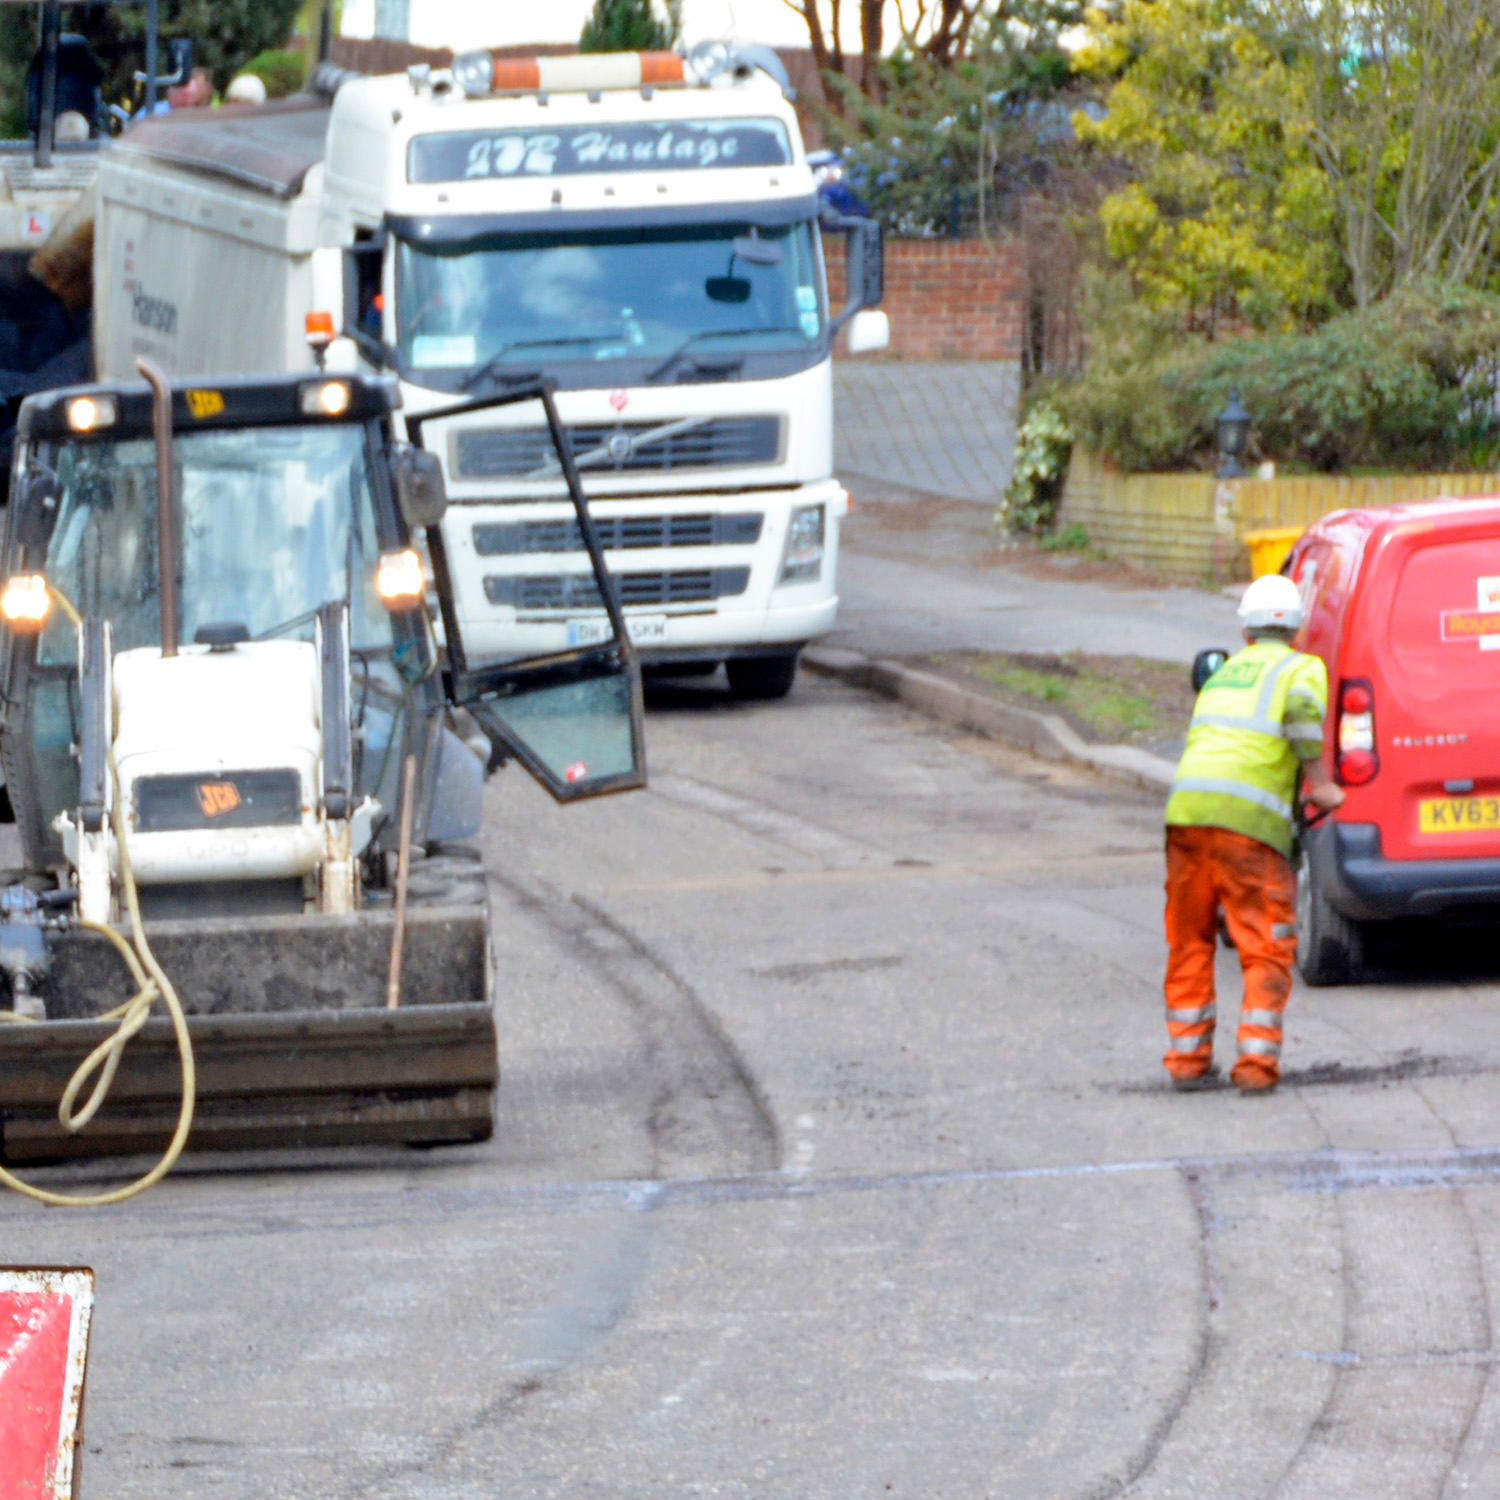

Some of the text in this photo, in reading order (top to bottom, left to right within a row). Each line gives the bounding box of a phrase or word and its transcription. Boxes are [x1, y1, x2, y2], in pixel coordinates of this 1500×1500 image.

[571, 131, 738, 167] Haulage
[200, 783, 240, 816] JCB
[1431, 799, 1500, 824] KV63
